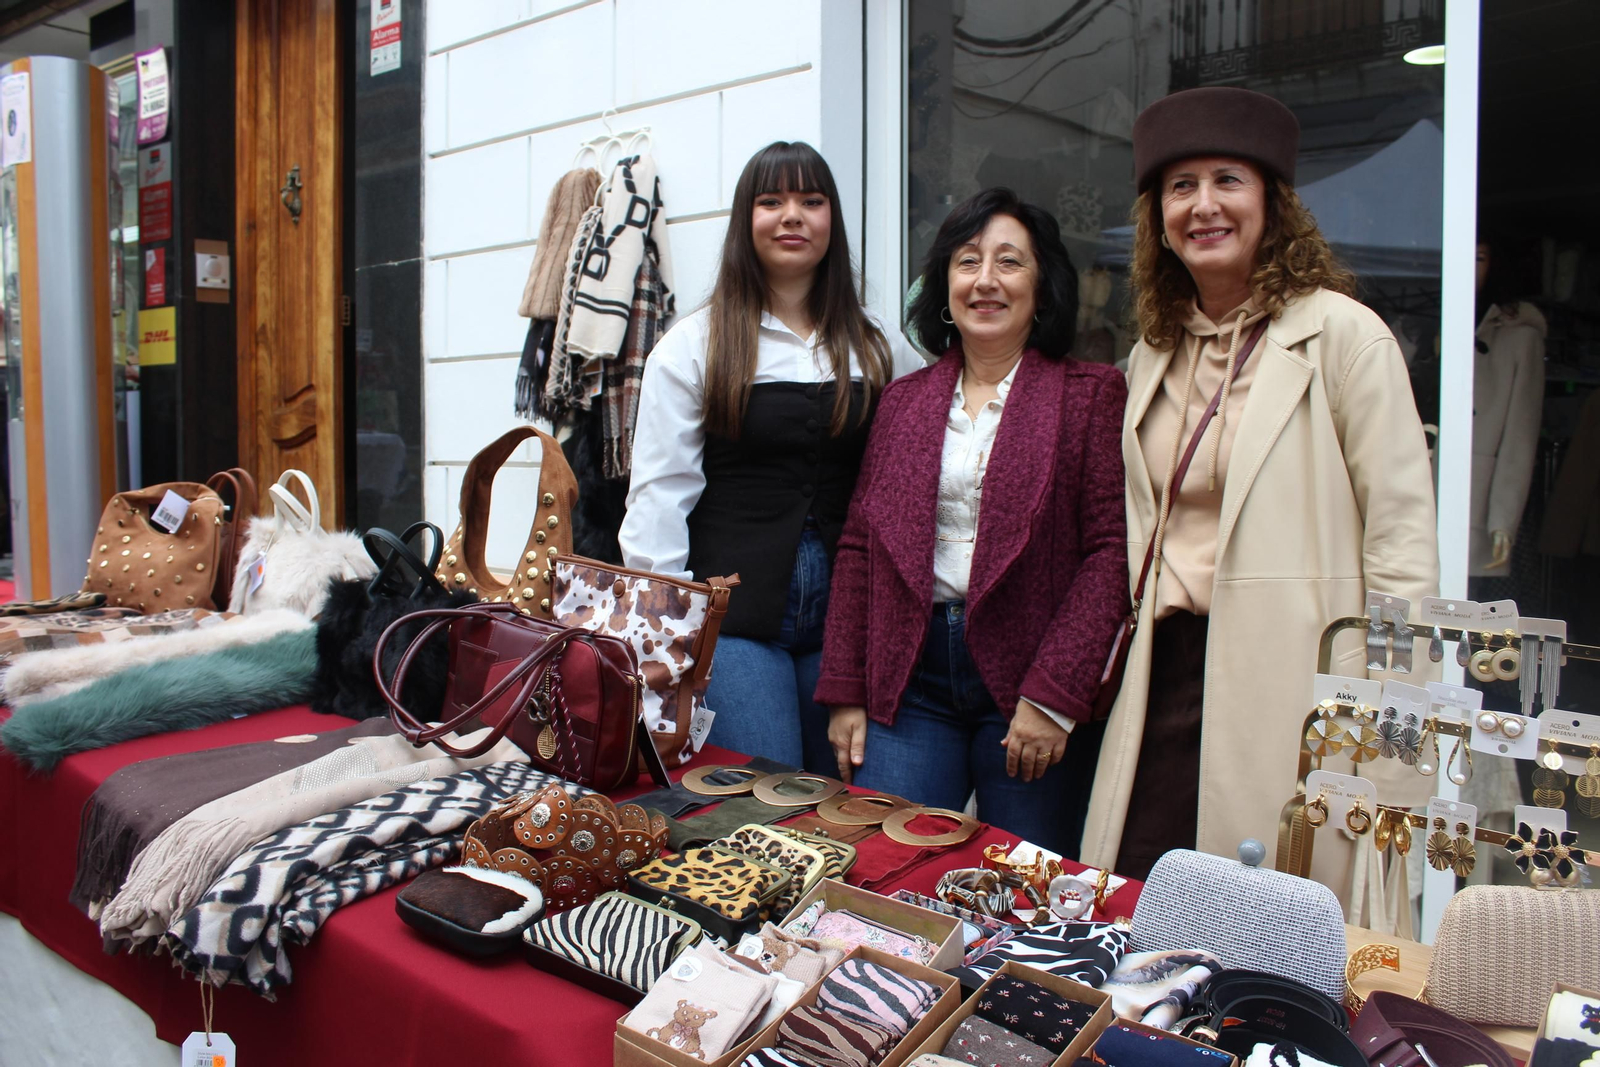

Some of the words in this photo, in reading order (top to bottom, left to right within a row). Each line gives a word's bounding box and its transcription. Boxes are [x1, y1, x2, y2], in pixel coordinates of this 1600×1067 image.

[373, 27, 399, 41] Alarma
[144, 329, 169, 343] DHL
[1335, 691, 1358, 703] Akky
[1549, 722, 1571, 731] ACERO
[1549, 728, 1577, 738] VIVIANA
[1581, 733, 1600, 741] MOD
[1319, 782, 1337, 790] ACERO
[1432, 801, 1448, 809] ACERO
